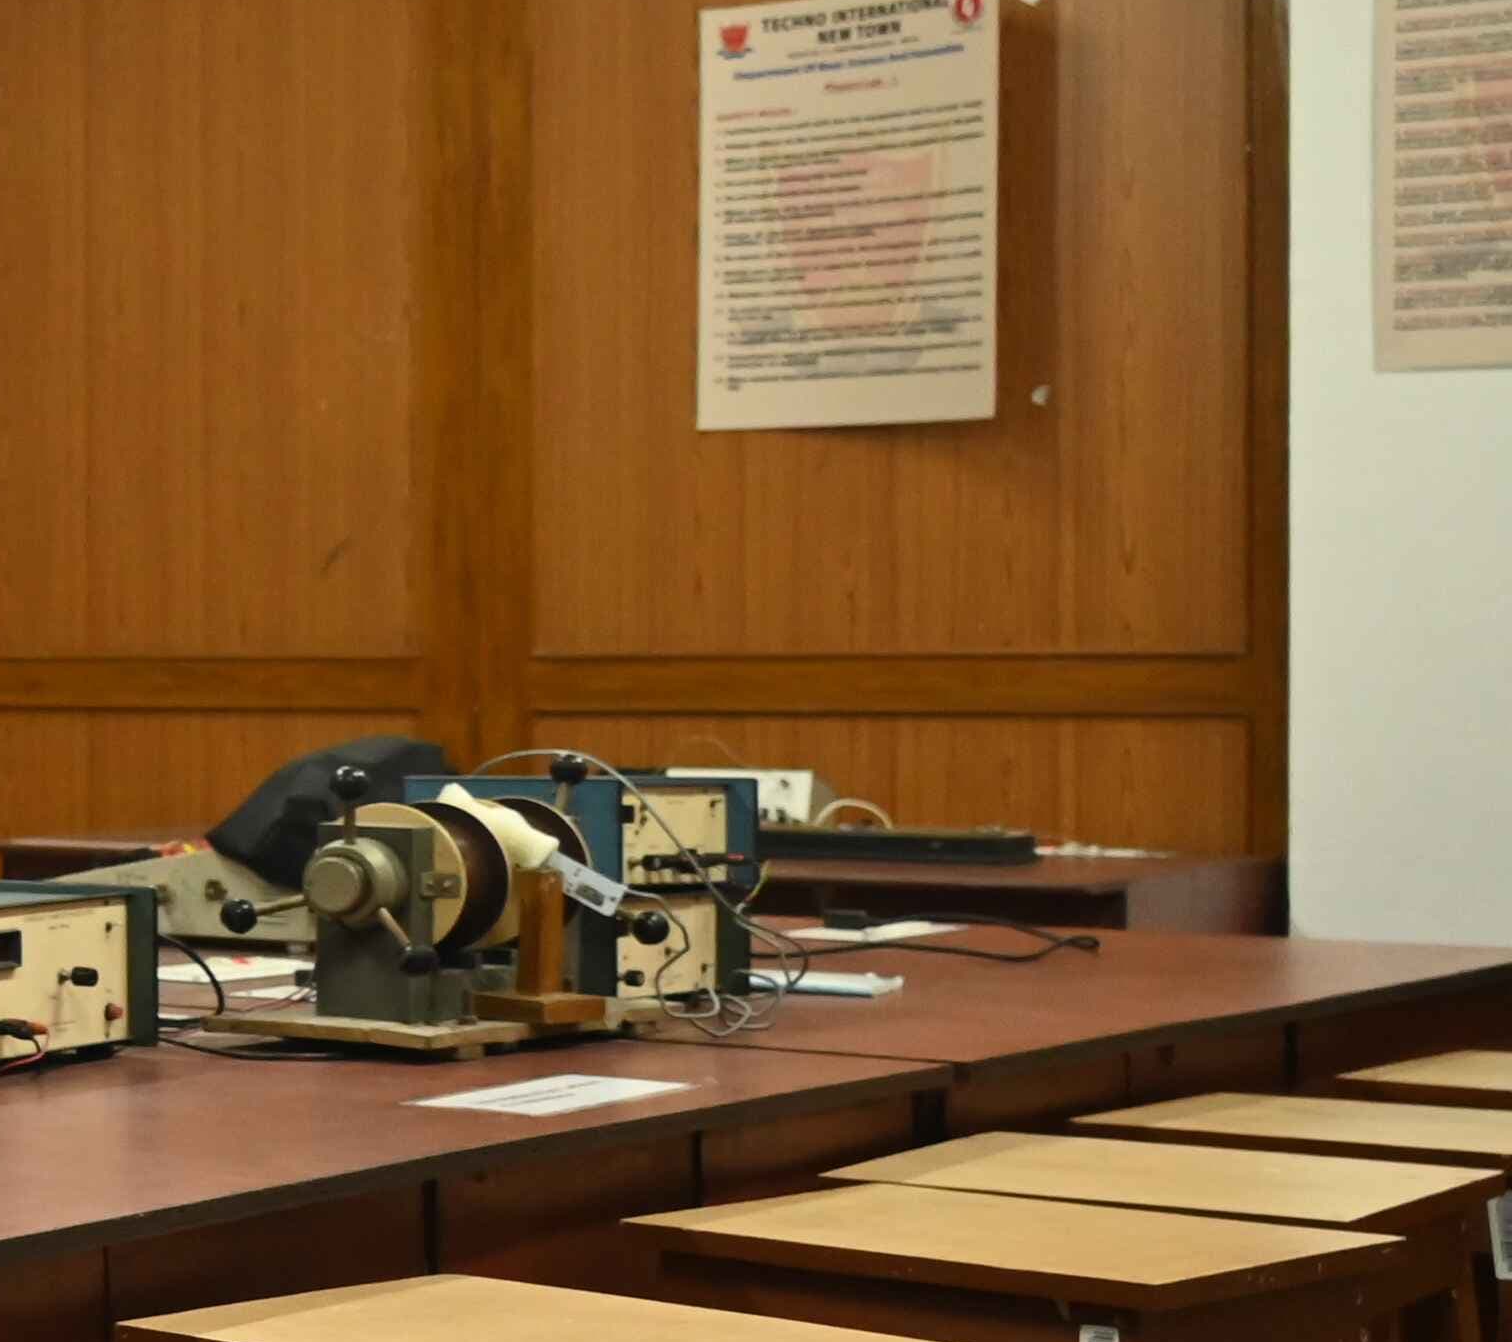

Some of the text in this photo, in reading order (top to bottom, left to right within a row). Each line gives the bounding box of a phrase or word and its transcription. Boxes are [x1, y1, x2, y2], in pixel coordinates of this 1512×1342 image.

[762, 12, 826, 34] TECHNO
[818, 20, 901, 45] NEW TOWN
